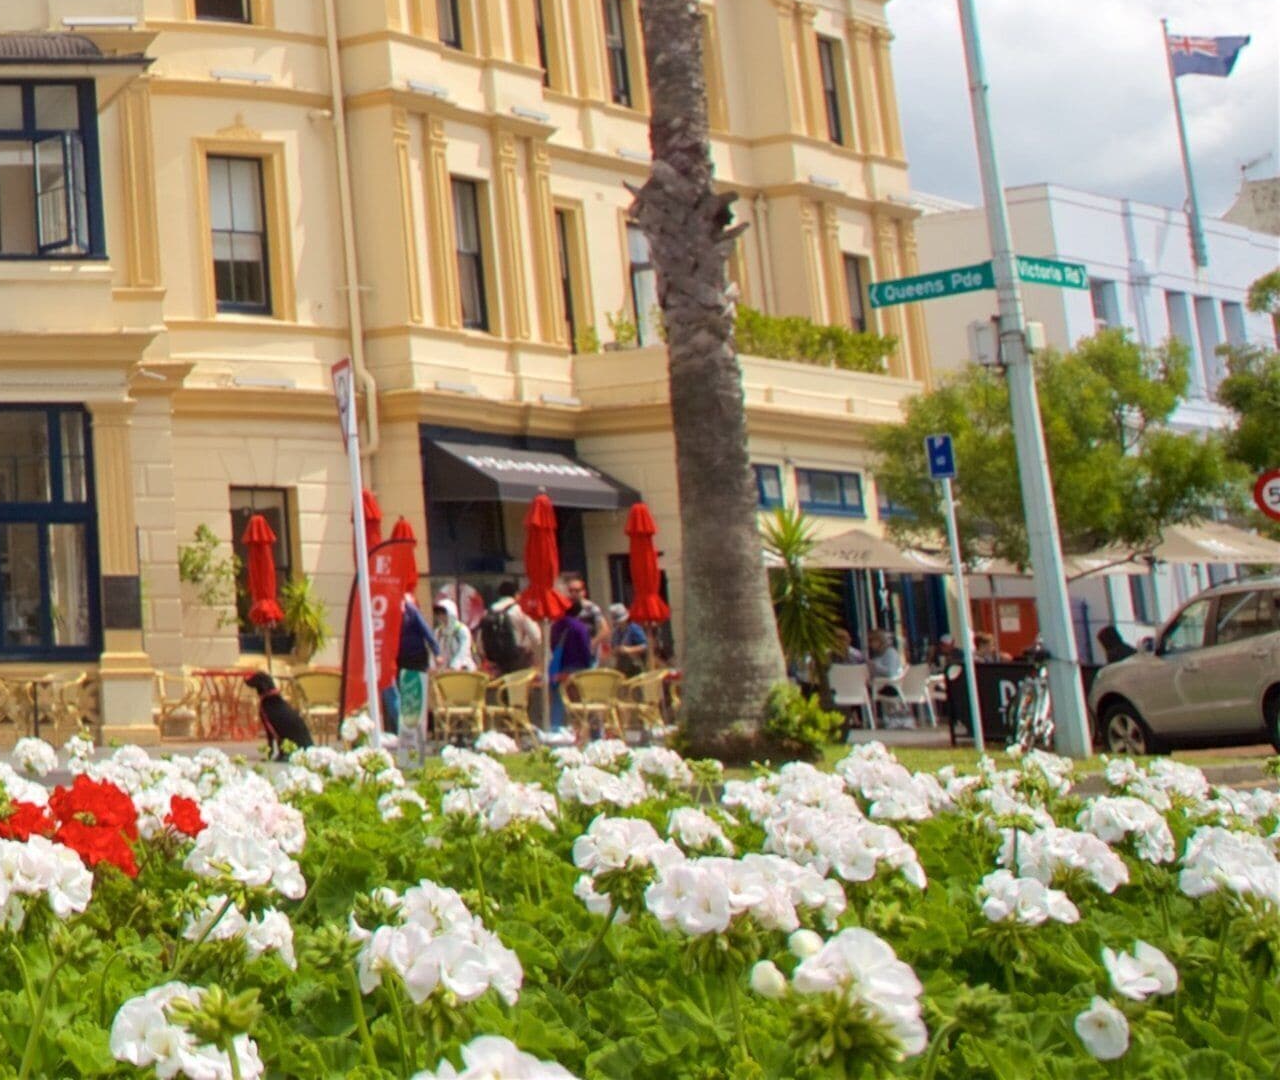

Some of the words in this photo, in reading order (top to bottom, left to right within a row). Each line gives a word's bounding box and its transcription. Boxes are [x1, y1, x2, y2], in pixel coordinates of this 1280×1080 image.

[1017, 259, 1063, 283] Victoria
[1064, 266, 1081, 284] Rd
[884, 280, 944, 301] Queens
[951, 270, 983, 290] Pde
[375, 555, 392, 574] E
